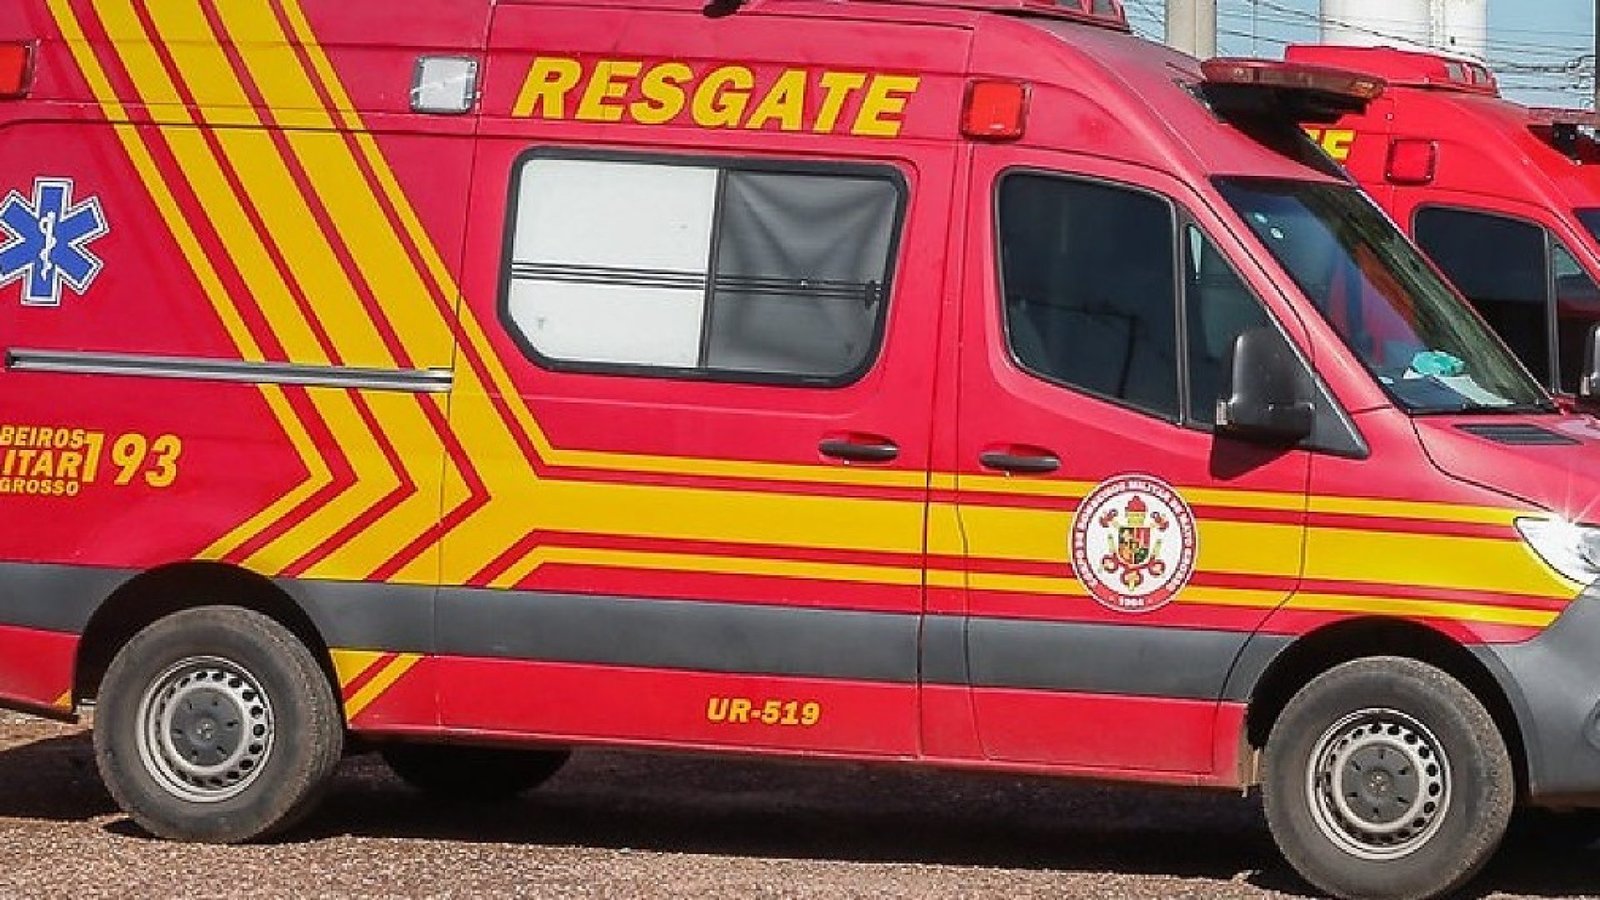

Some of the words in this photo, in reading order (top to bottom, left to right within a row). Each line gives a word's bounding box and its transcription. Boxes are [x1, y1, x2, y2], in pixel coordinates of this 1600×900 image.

[511, 56, 920, 137] RESGATE
[0, 425, 84, 449] BEIROS
[82, 432, 182, 488] 193
[0, 476, 79, 497] GROSSO
[707, 697, 820, 725] UR-519
